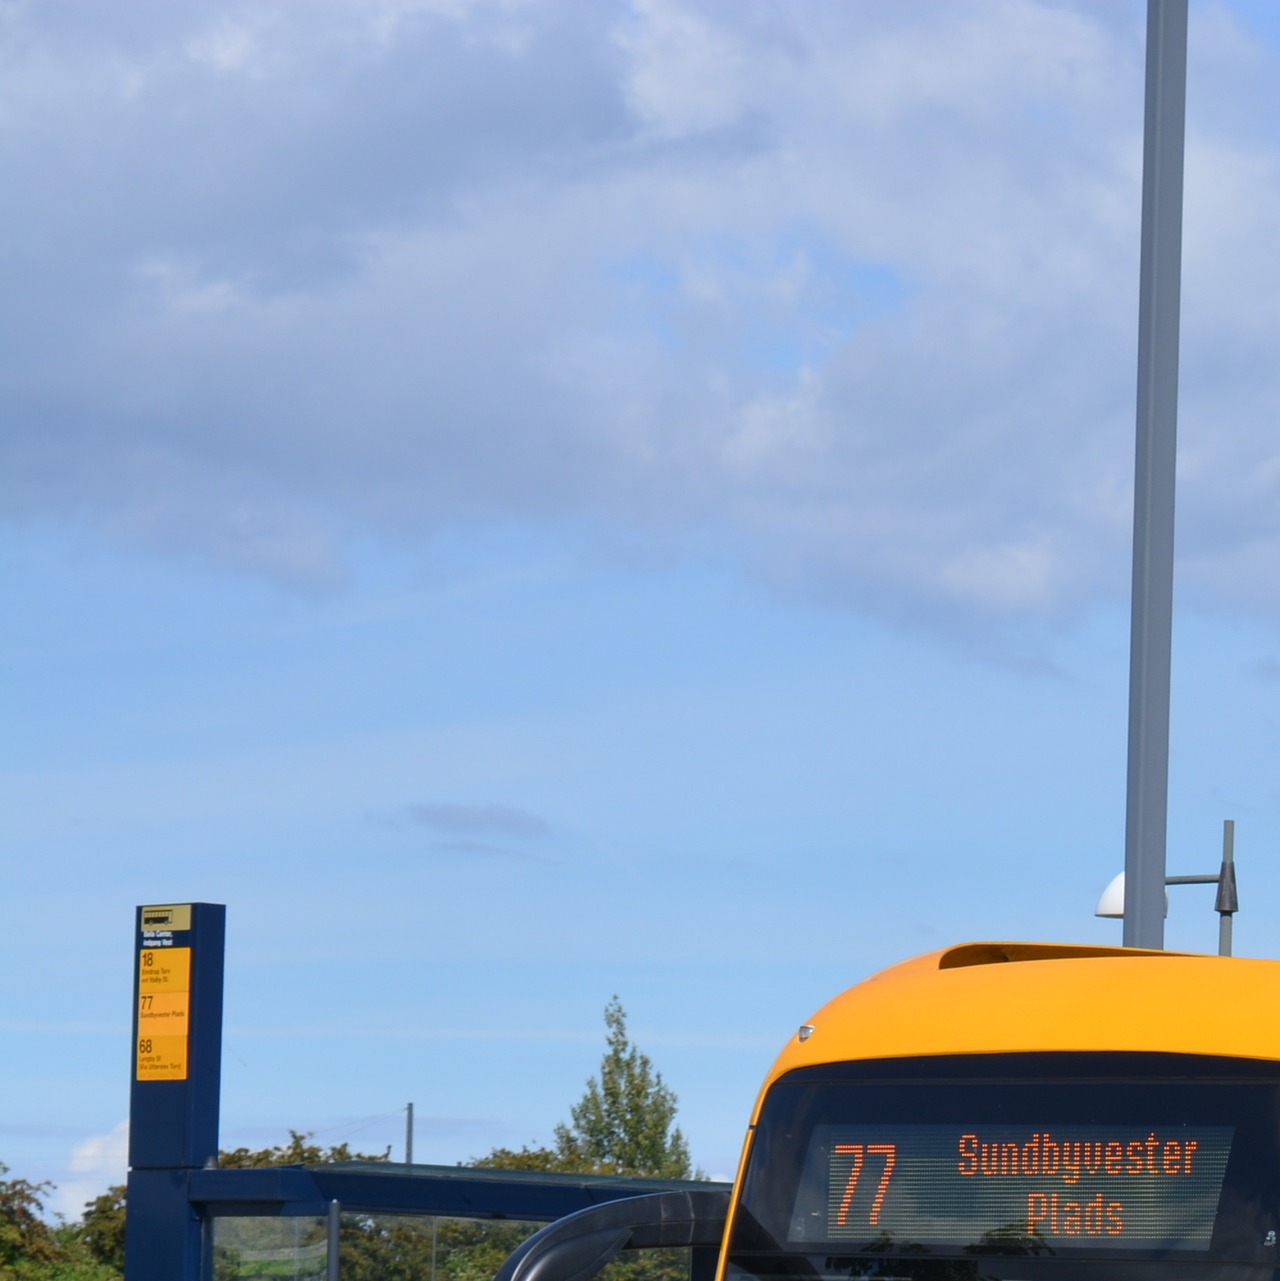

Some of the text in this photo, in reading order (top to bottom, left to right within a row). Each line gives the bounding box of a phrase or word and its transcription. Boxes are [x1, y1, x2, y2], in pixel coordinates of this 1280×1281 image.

[142, 952, 153, 967] 18
[141, 996, 153, 1010] 77
[139, 1038, 152, 1054] 68
[958, 1131, 1198, 1183] Sundbyvester
[834, 1144, 895, 1225] 77
[1026, 1192, 1125, 1236] Plads
